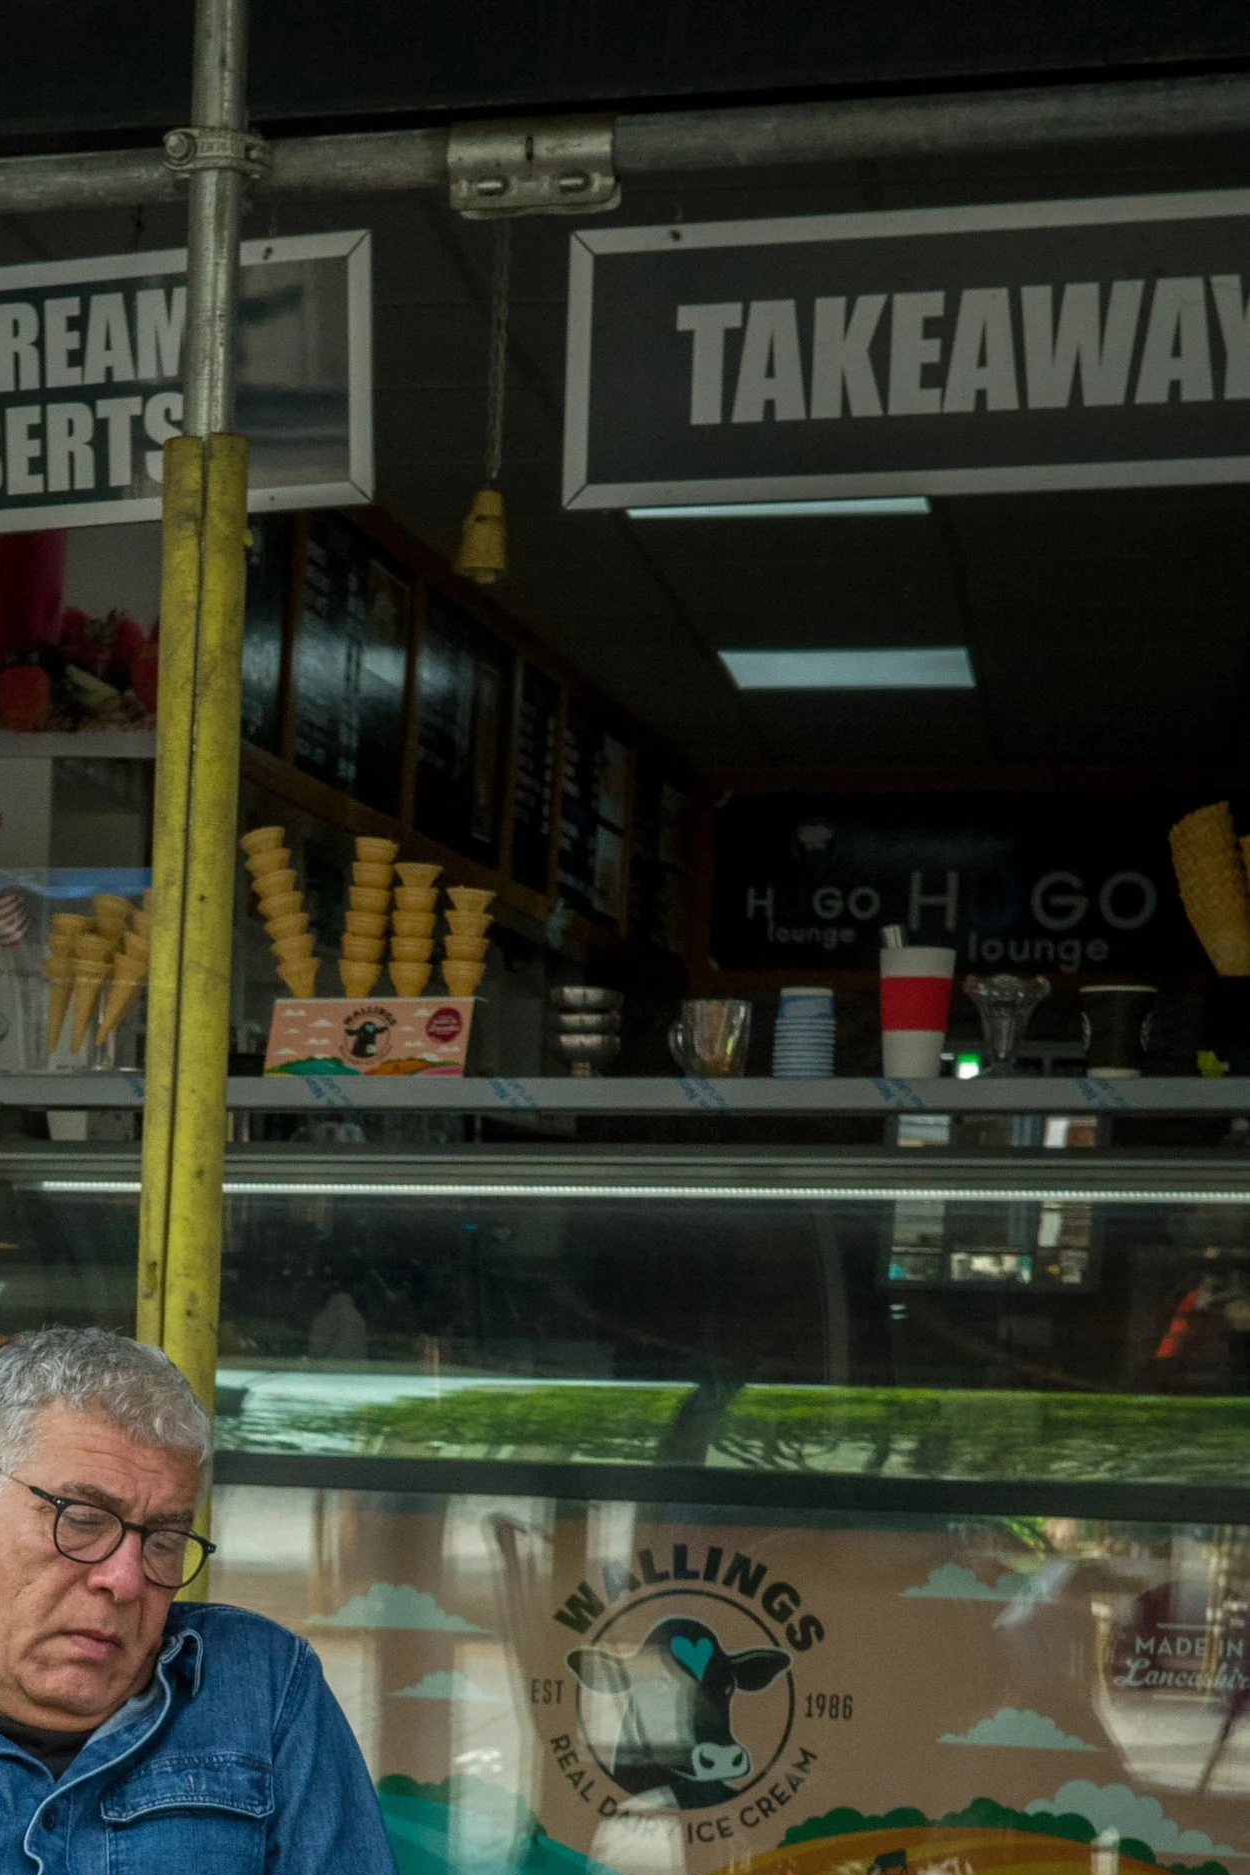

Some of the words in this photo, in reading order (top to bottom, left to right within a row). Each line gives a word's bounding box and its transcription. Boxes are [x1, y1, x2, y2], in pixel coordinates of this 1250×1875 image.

[676, 273, 1250, 426] TAKEAWAY
[766, 914, 857, 951] lounge
[969, 932, 1111, 974] lounge
[553, 1544, 826, 1653] WALLINGS
[1134, 1635, 1206, 1657] MADE
[1217, 1638, 1245, 1659] IN
[531, 1678, 565, 1705] EST
[804, 1692, 854, 1721] 1986
[550, 1733, 598, 1802] REAL
[686, 1816, 734, 1845] ICE
[738, 1746, 819, 1829] CREAM
